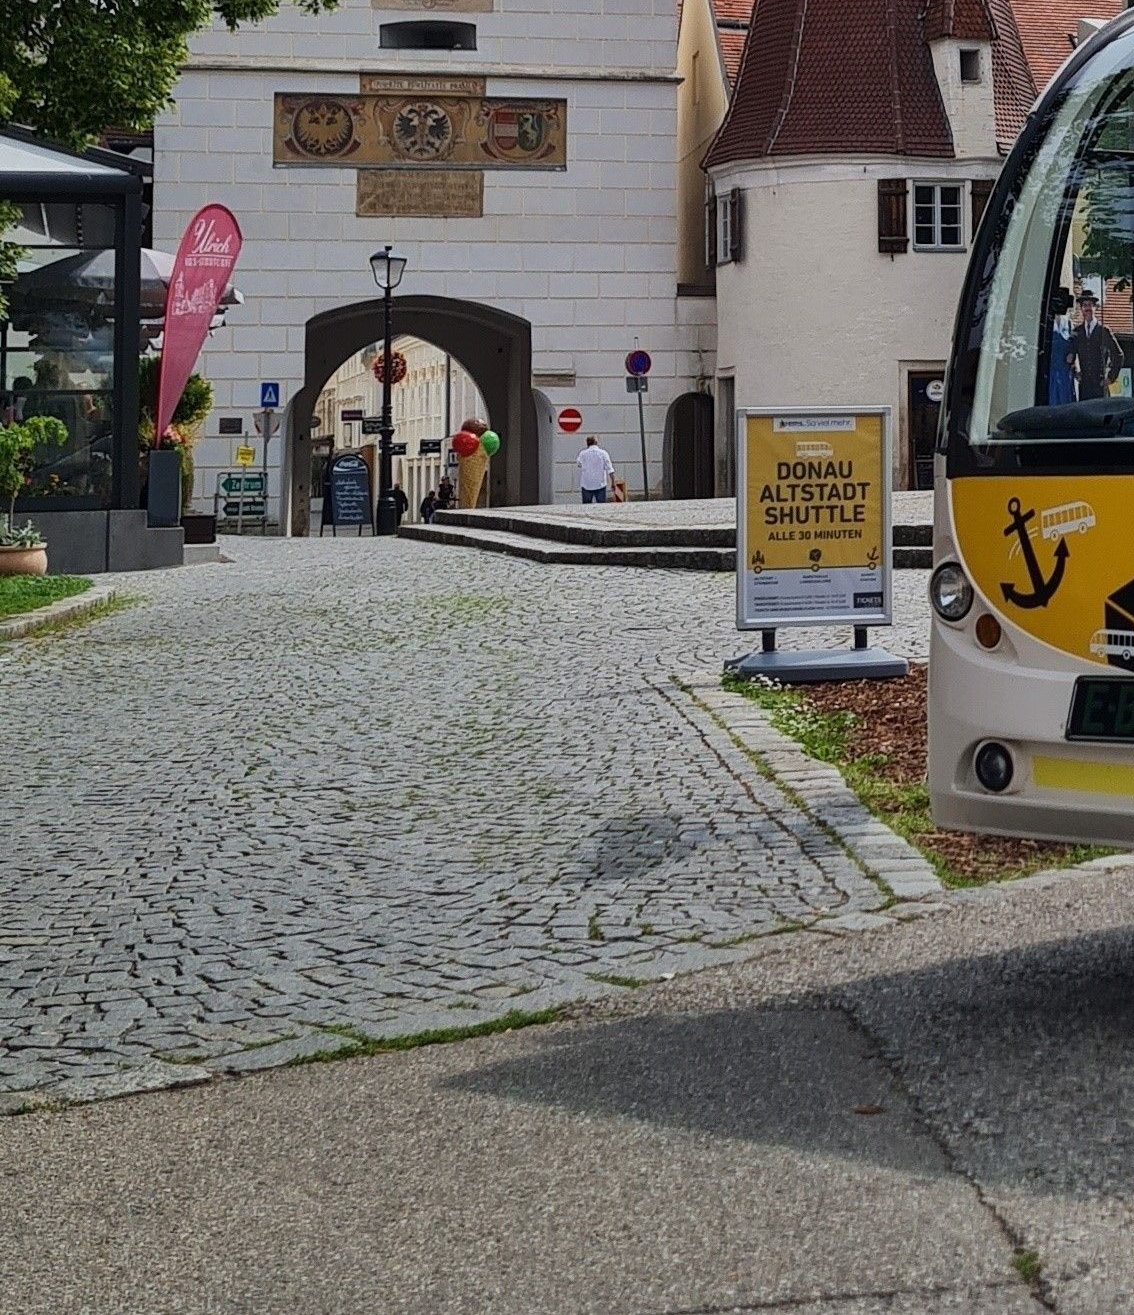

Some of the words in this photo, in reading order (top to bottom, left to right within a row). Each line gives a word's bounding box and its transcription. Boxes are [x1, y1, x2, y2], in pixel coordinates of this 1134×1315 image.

[191, 218, 232, 254] Ulrich
[777, 461, 853, 480] DONAU
[759, 482, 870, 503] ALTSTADT
[764, 505, 866, 526] SHUTTLE
[768, 531, 796, 541] ALLE
[798, 531, 812, 541] 30
[814, 529, 863, 540] MINUTEN
